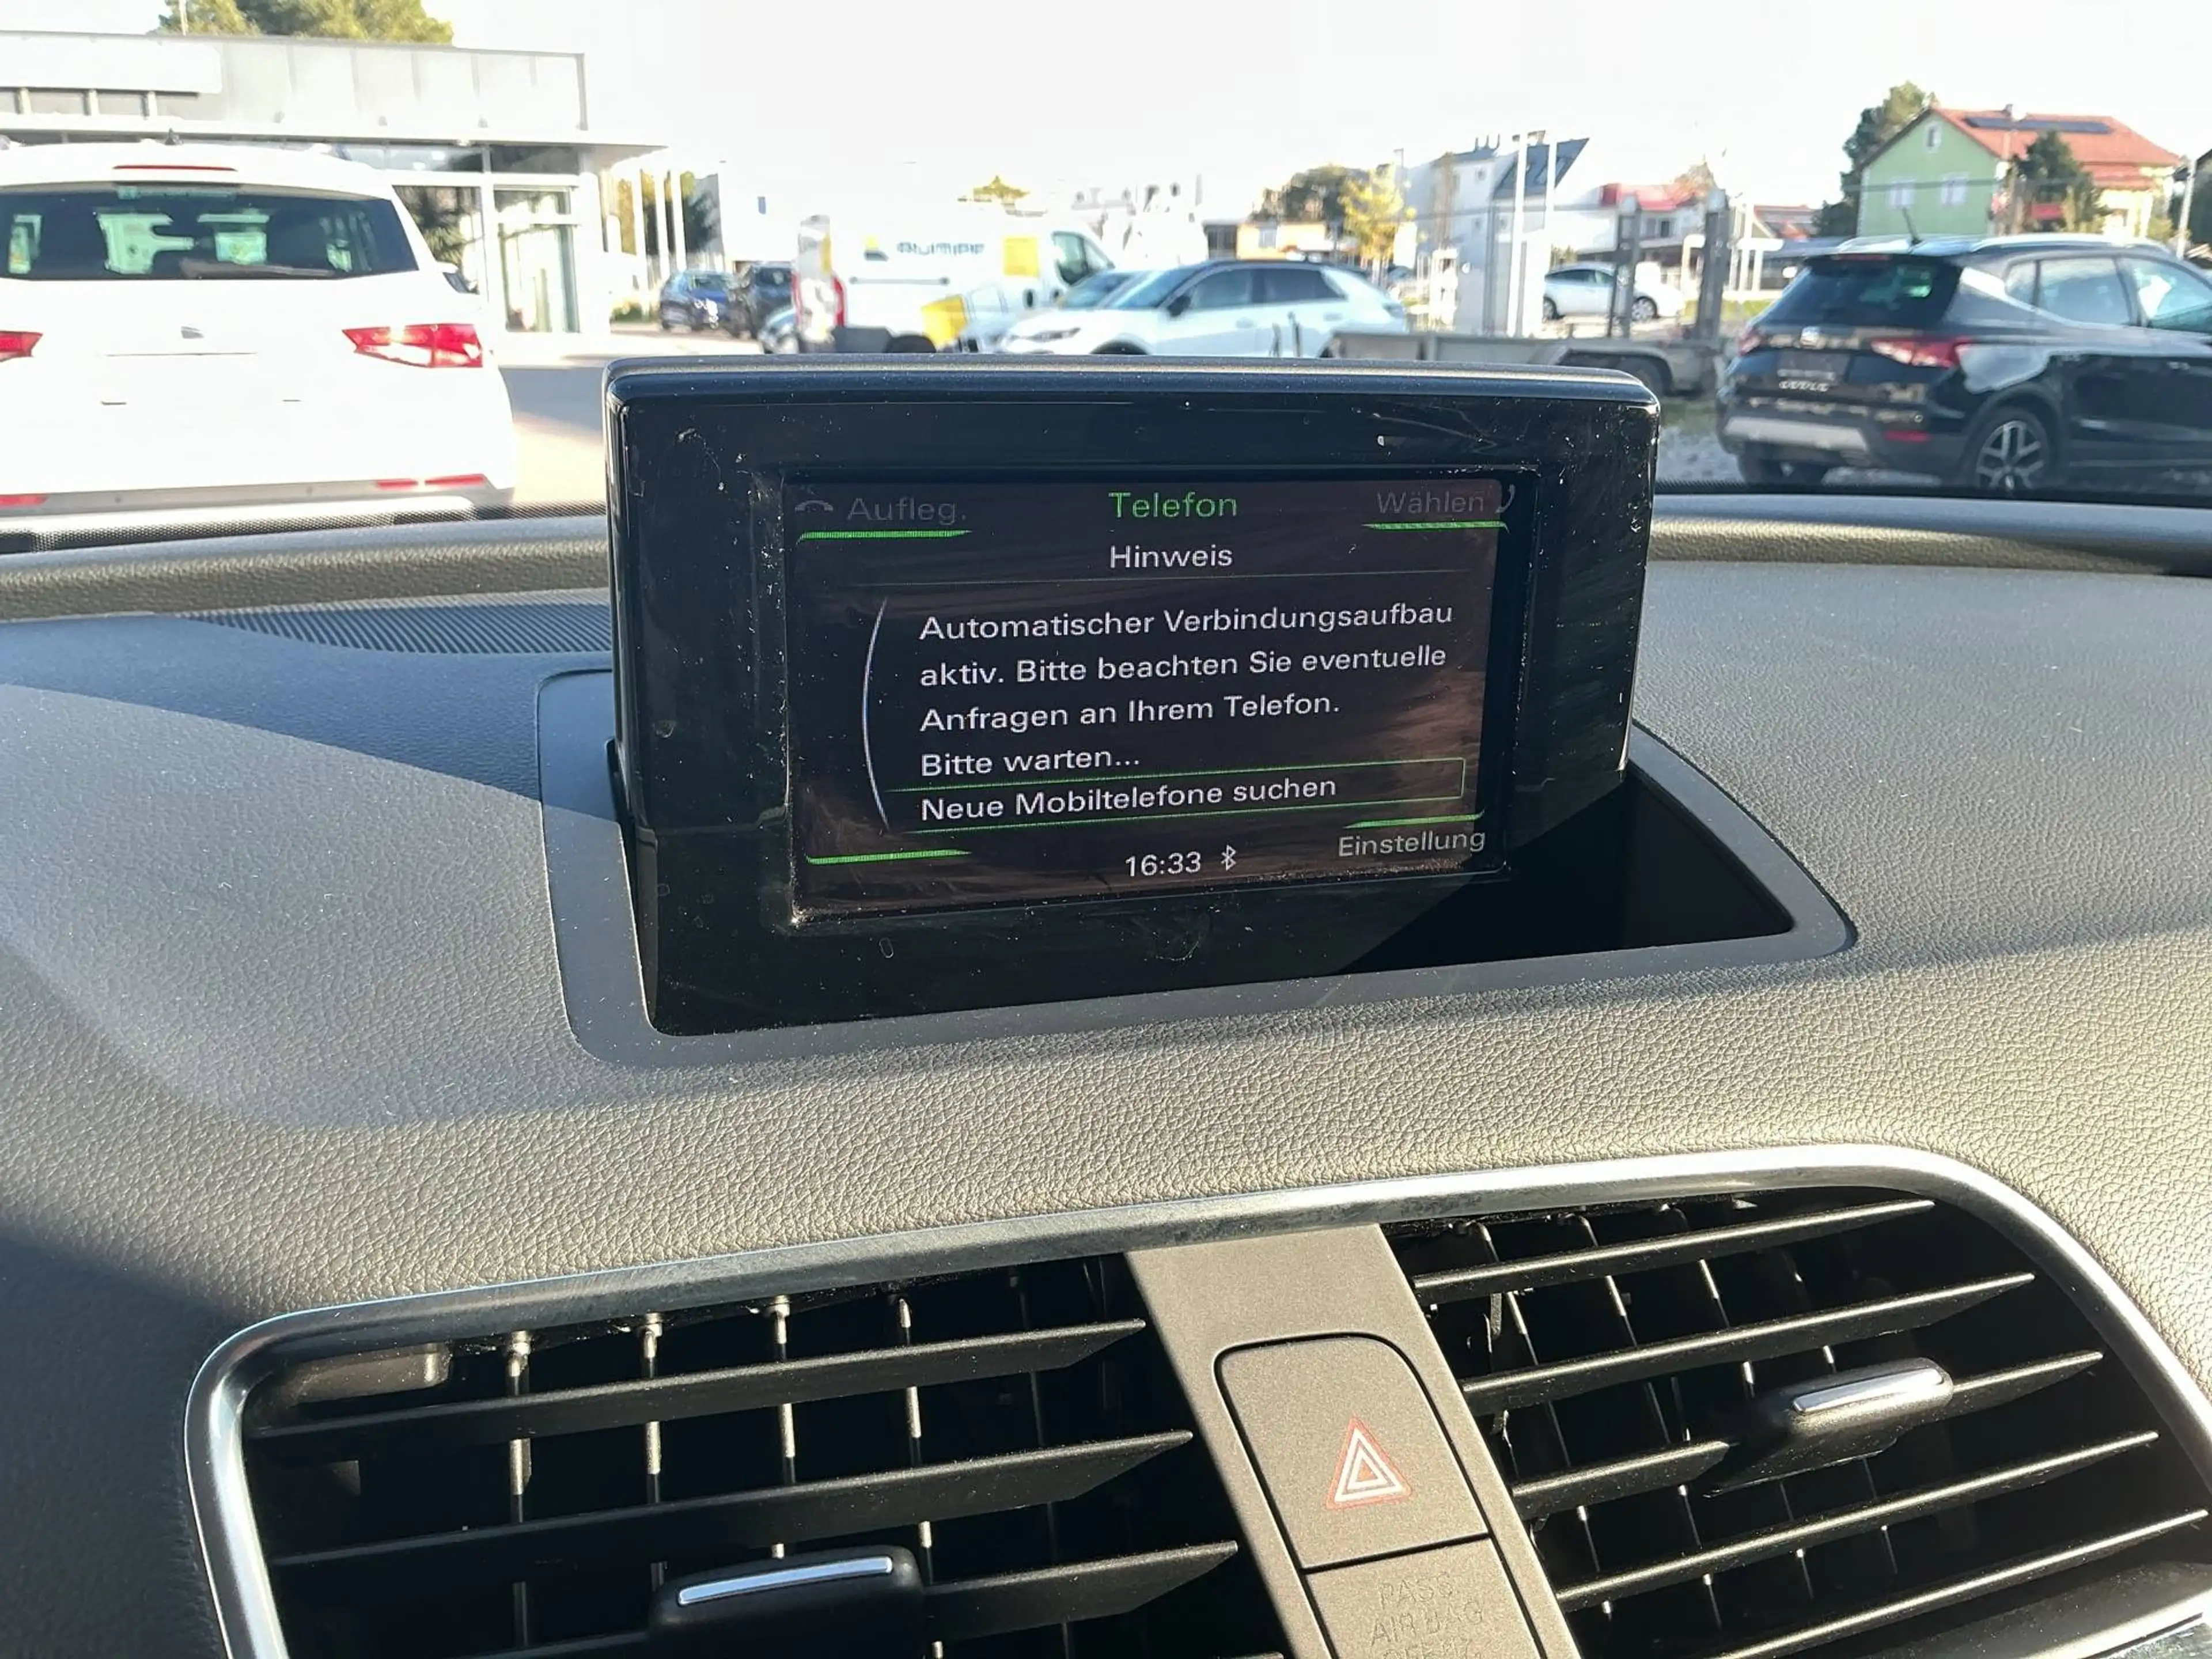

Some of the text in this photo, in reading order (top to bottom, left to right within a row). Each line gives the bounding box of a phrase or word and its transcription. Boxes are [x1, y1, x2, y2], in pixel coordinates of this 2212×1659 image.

[847, 498, 965, 525] Aufleg.
[1108, 491, 1237, 518] Telefon
[1377, 491, 1483, 514] Wählen
[1110, 543, 1233, 569] Hinweis
[918, 602, 1452, 641] Automatischer Verbindungsaufbau
[920, 644, 1446, 687] aktiv. Bitte beachten Sie eventuelle
[919, 692, 1339, 733] Anfragen an Ihrem Telefon.
[921, 749, 1139, 777] Bitte warten...
[921, 778, 1338, 821] Neue Mobiltelefone suchen
[1338, 830, 1486, 857] Einstellung
[1125, 851, 1202, 877] 16:33
[1377, 1571, 1453, 1609] PASS
